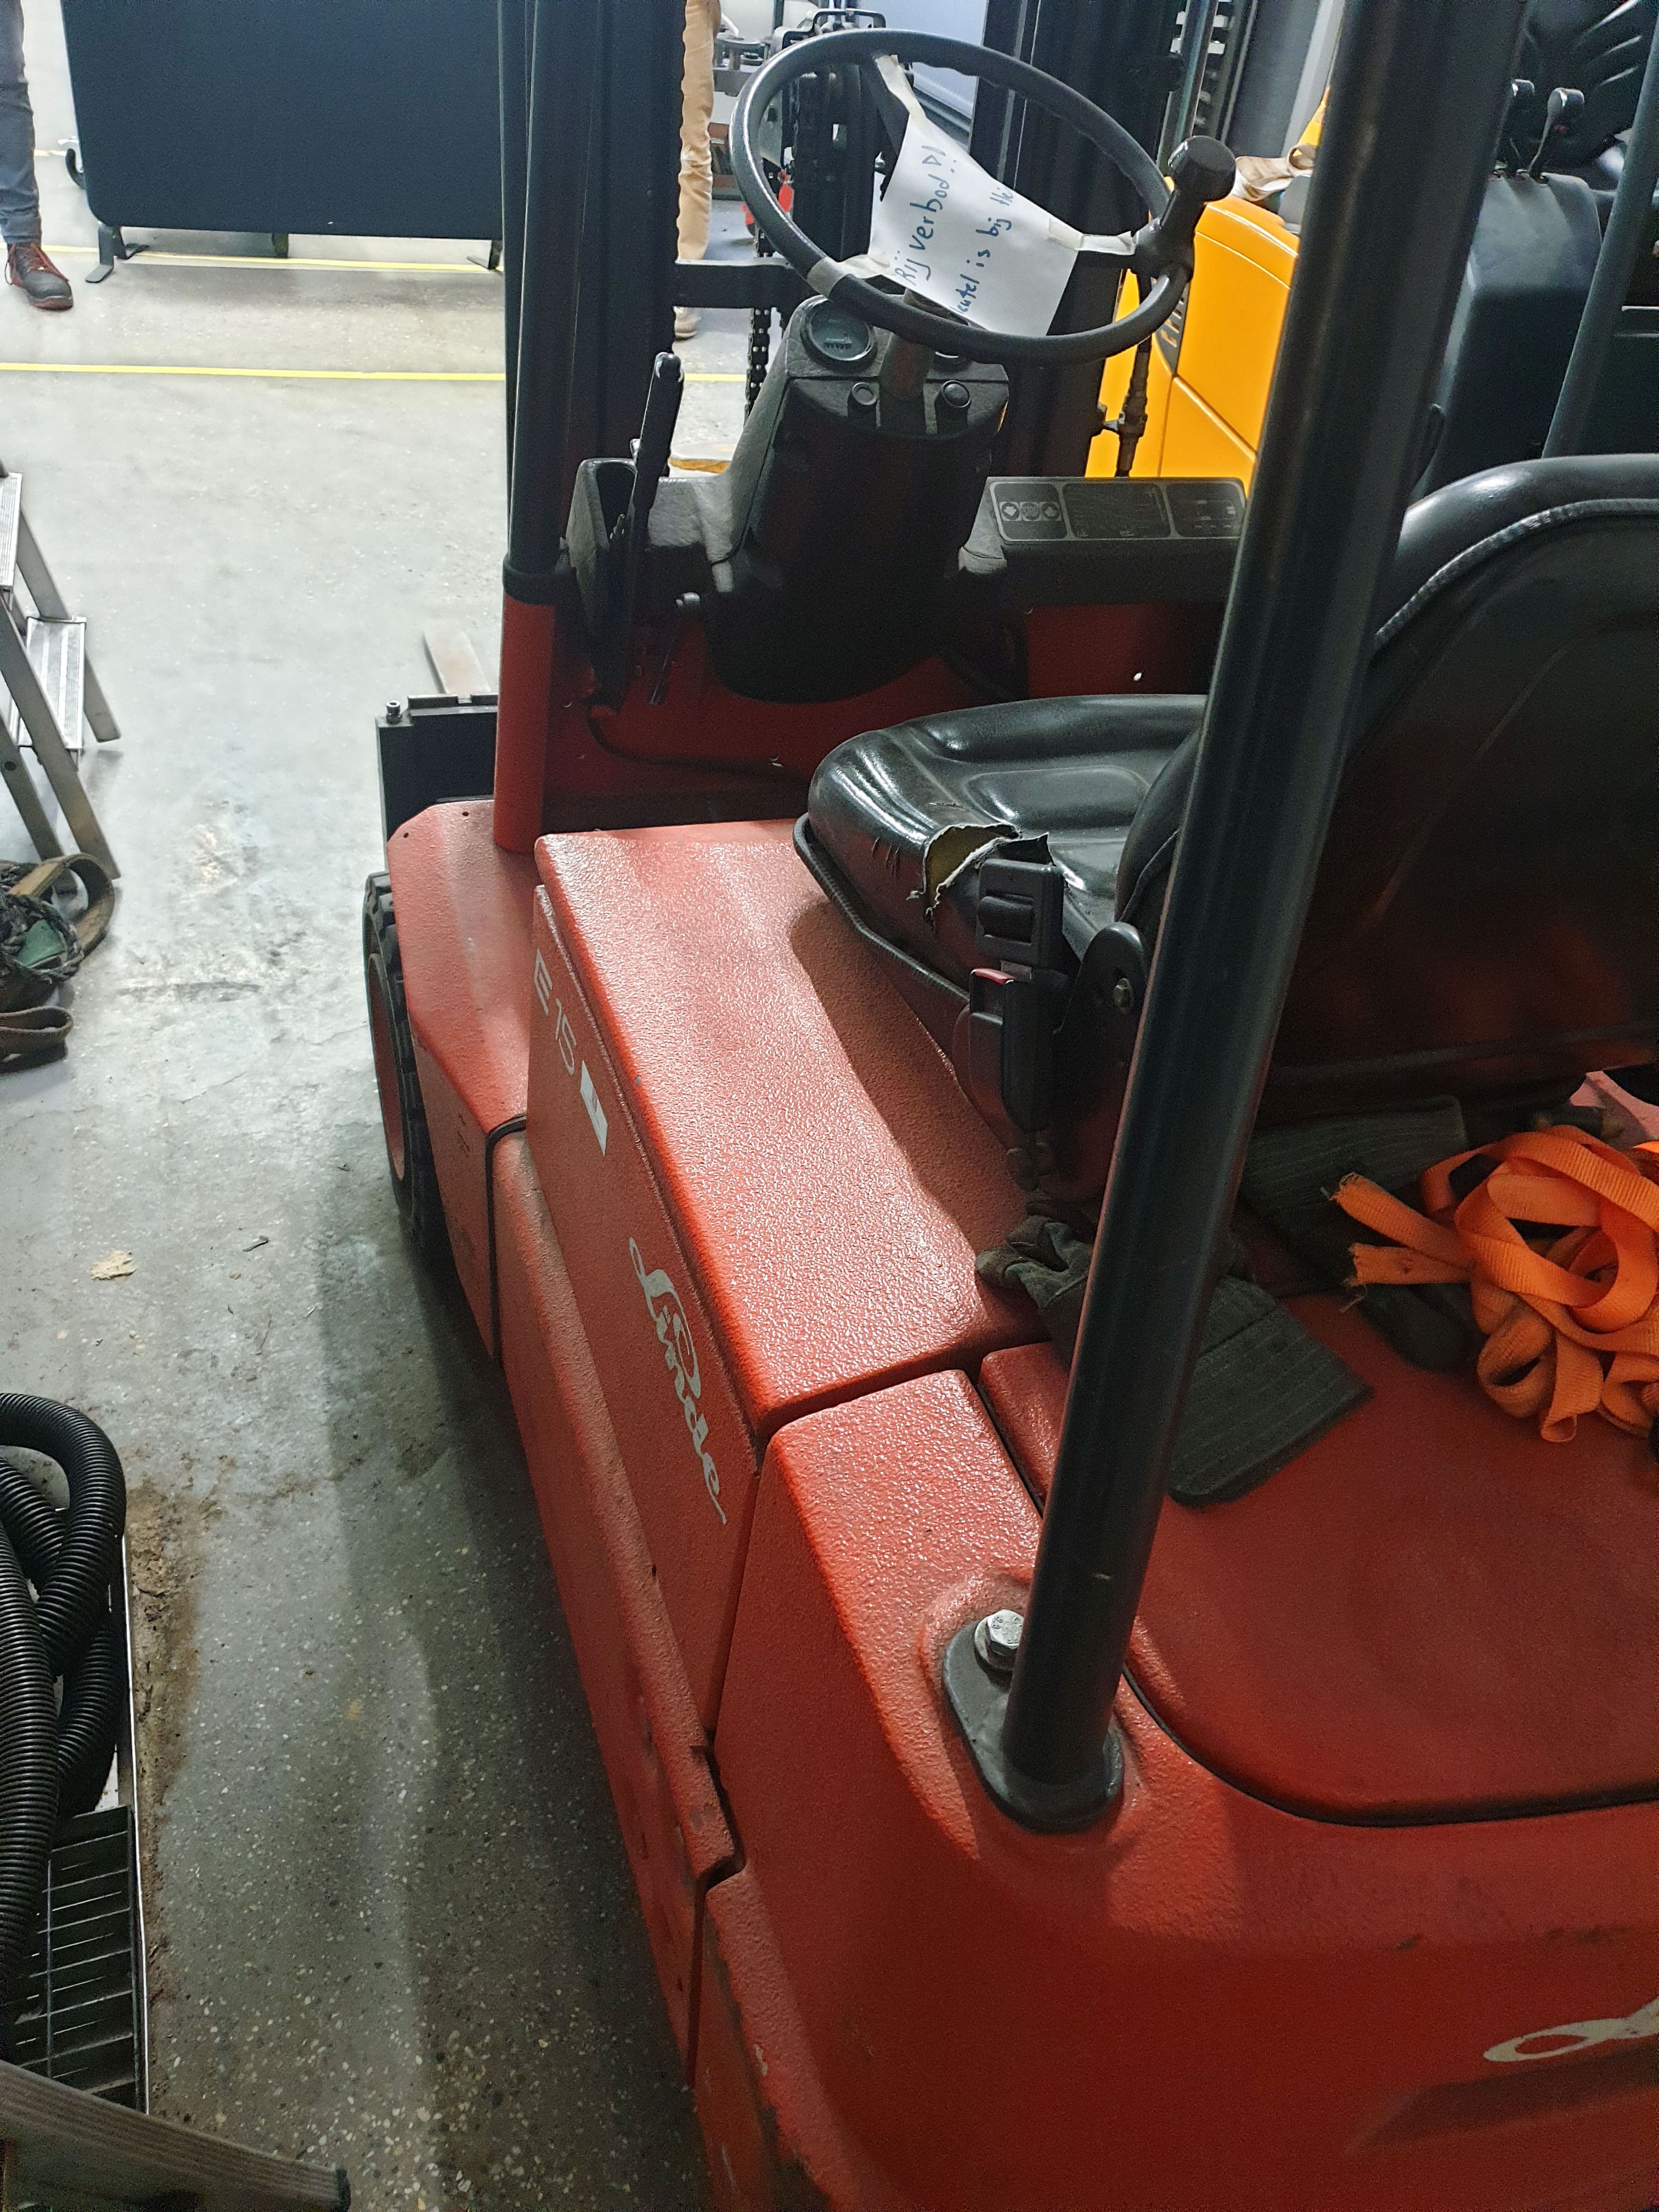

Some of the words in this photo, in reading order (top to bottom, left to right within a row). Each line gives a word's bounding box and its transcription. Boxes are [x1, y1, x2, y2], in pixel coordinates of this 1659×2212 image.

[966, 250, 990, 267] is
[975, 217, 1012, 237] bij
[534, 947, 552, 1015] E
[555, 998, 577, 1076] 15
[629, 1237, 727, 1526] Linde
